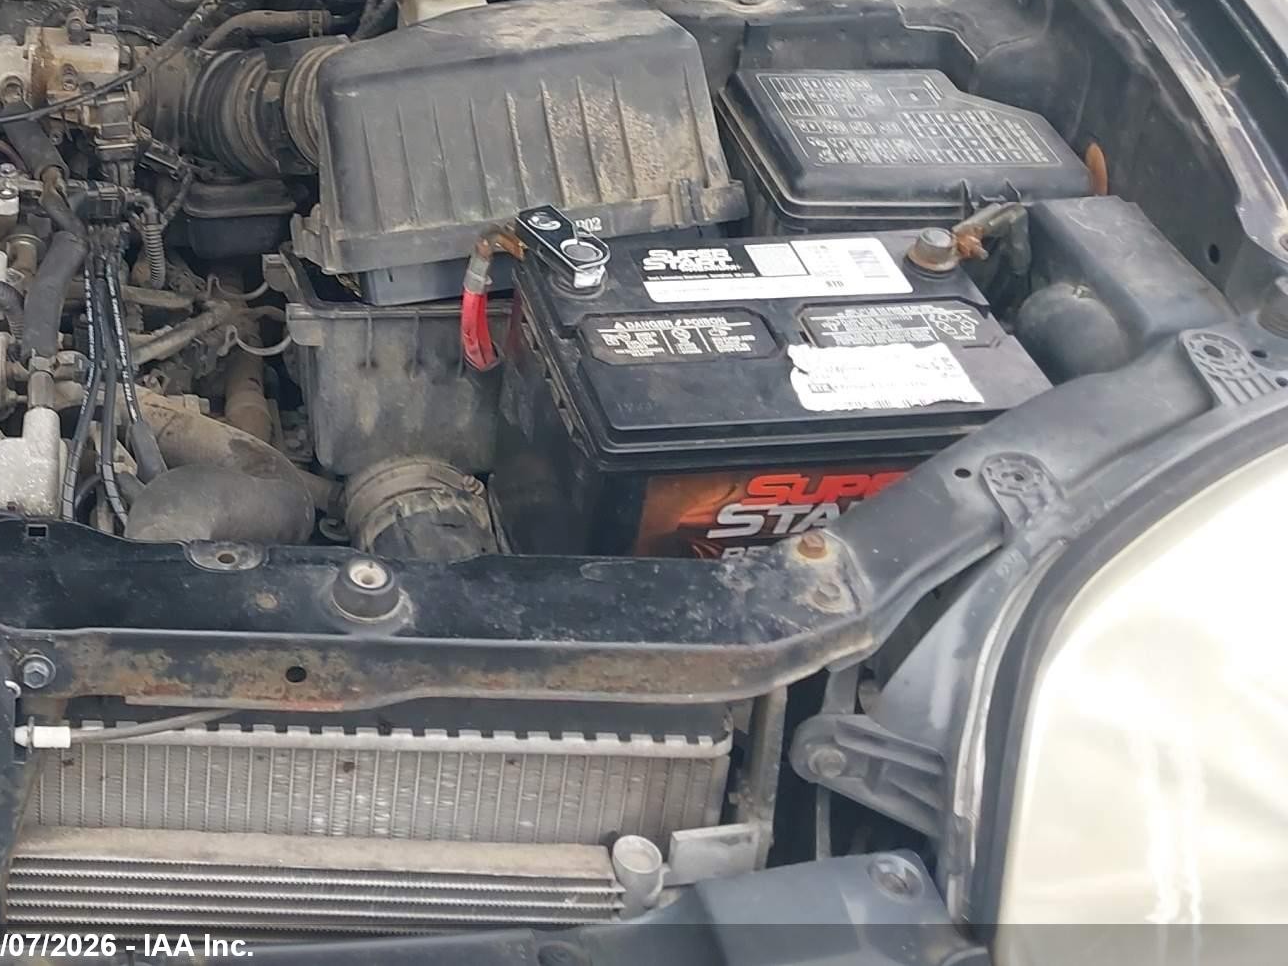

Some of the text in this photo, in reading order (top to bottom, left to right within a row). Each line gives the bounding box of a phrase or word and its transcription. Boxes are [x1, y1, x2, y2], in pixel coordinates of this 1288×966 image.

[648, 249, 731, 261] SUPER
[642, 257, 733, 272] START
[625, 320, 674, 330] DANGER
[683, 317, 727, 328] POISON
